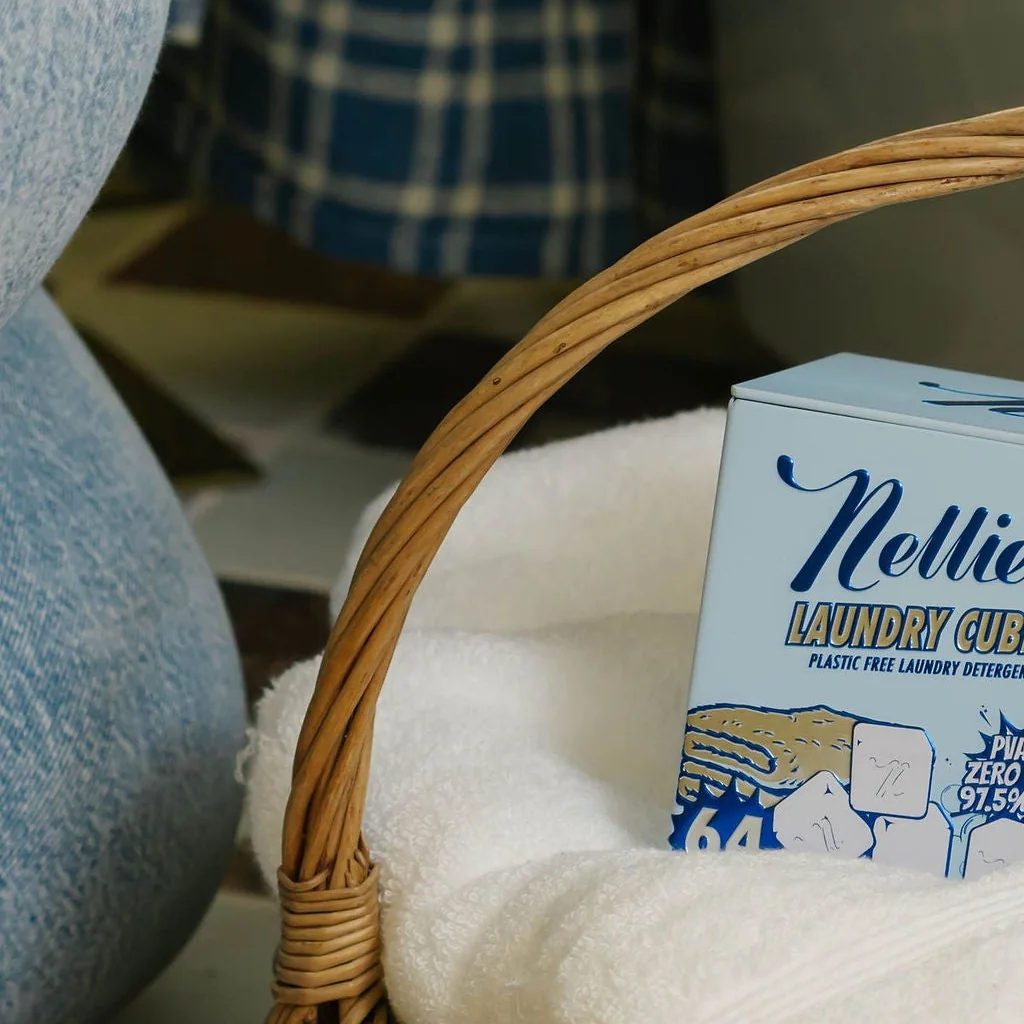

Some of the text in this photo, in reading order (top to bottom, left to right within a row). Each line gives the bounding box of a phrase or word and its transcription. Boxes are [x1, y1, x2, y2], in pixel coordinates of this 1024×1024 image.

[785, 600, 955, 652] LAUNDRY
[808, 653, 860, 670] PLASTIC
[863, 656, 896, 673] FREE
[898, 658, 961, 676] LAUNDRY
[964, 761, 1022, 787] ZERO
[684, 807, 764, 853] 64
